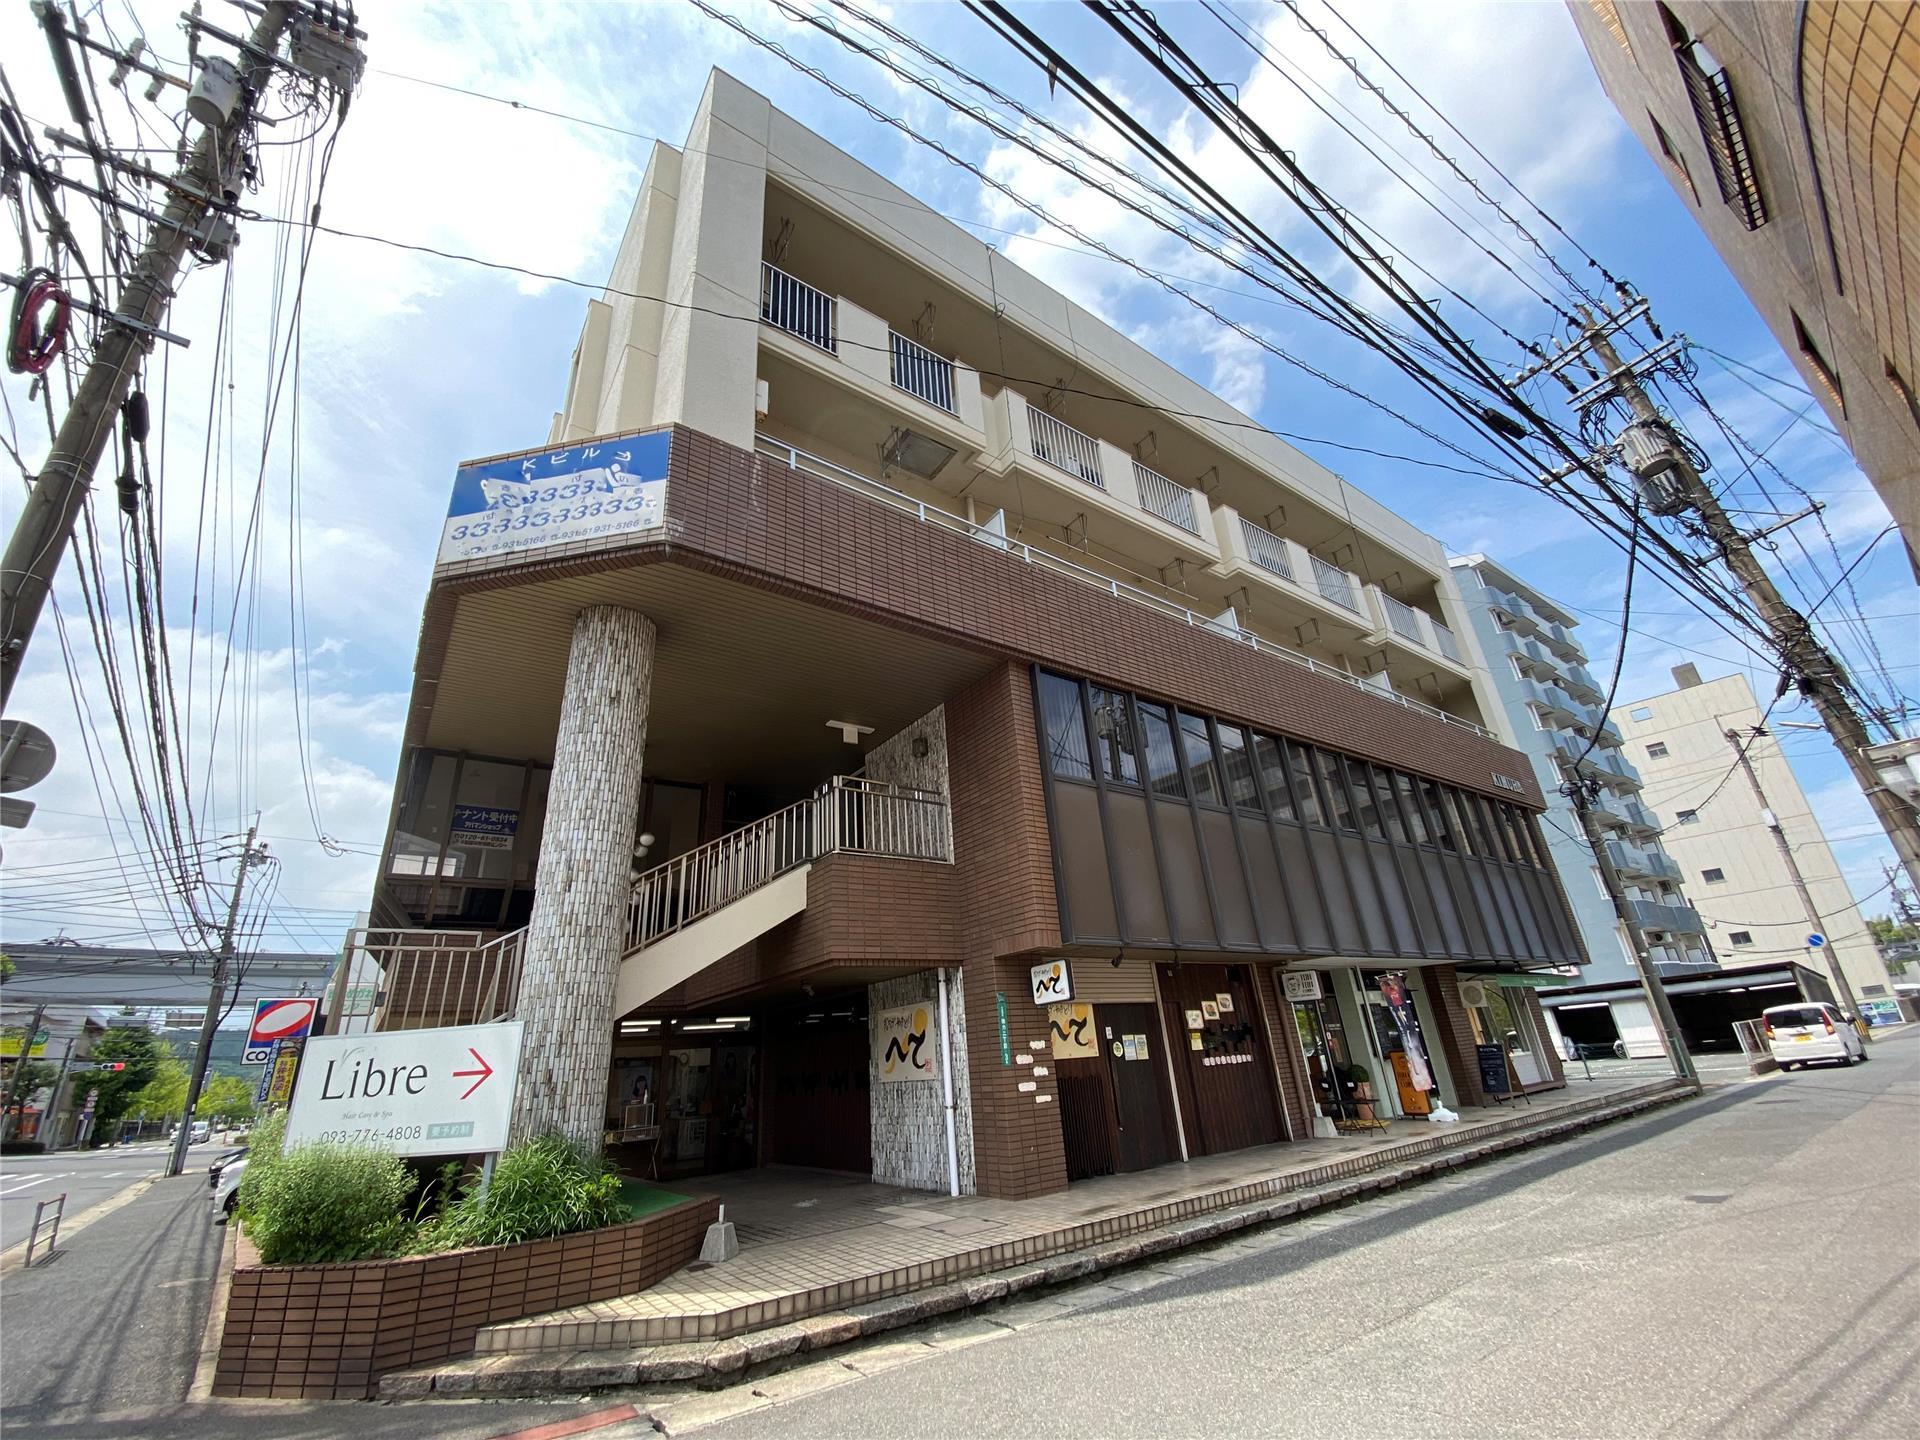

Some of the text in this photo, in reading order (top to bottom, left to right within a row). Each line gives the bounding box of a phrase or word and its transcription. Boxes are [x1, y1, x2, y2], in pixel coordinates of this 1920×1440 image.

[319, 1057, 428, 1101] Libre
[381, 1110, 393, 1120] Spa
[320, 1125, 422, 1145] 093-776-4808
